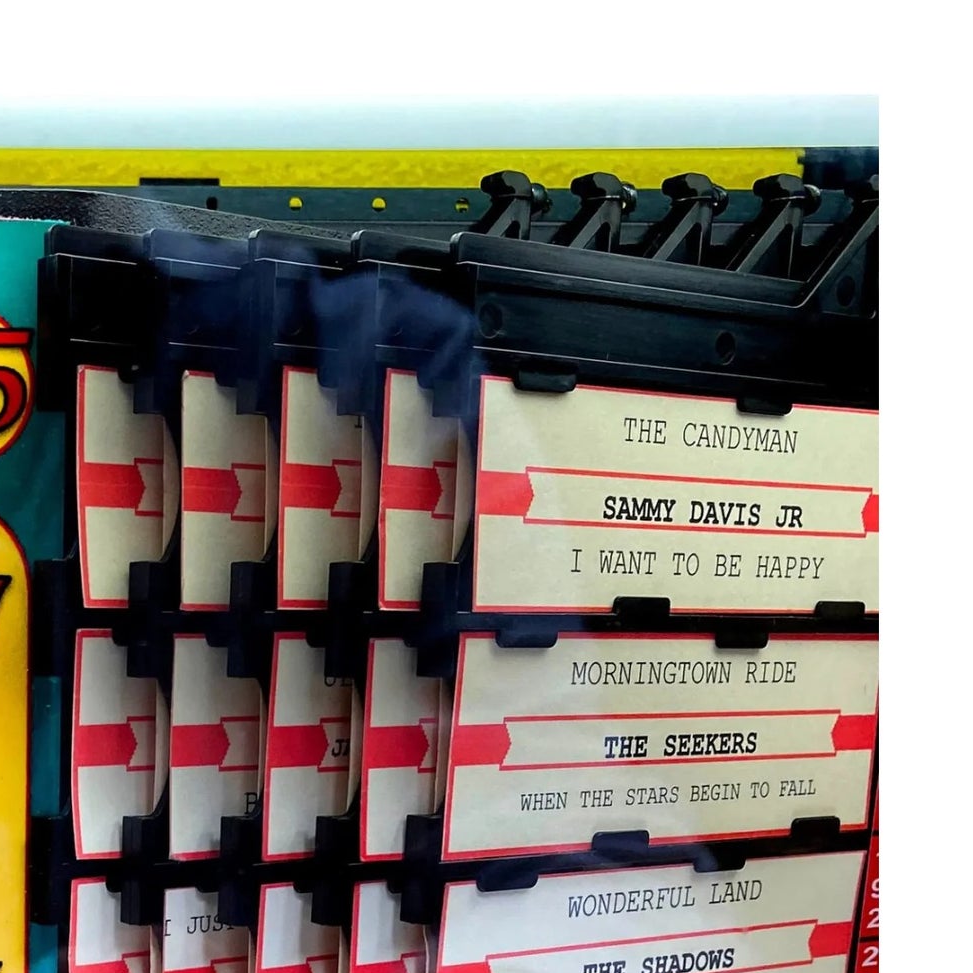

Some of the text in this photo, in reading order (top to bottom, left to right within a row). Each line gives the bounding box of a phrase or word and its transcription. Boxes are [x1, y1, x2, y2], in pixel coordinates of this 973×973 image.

[624, 418, 798, 453] THE CANDYMAN
[603, 496, 802, 527] SAMMY DAVIS JR
[571, 549, 824, 579] I WANT TO BE HAPPY
[571, 662, 796, 685] MORNINGTOWN RIDE
[605, 732, 757, 758] THE SEEKERS
[521, 779, 816, 811] WHEN THE STARS BEGIN TO FALL
[569, 880, 762, 917] WONDERFUL LAND
